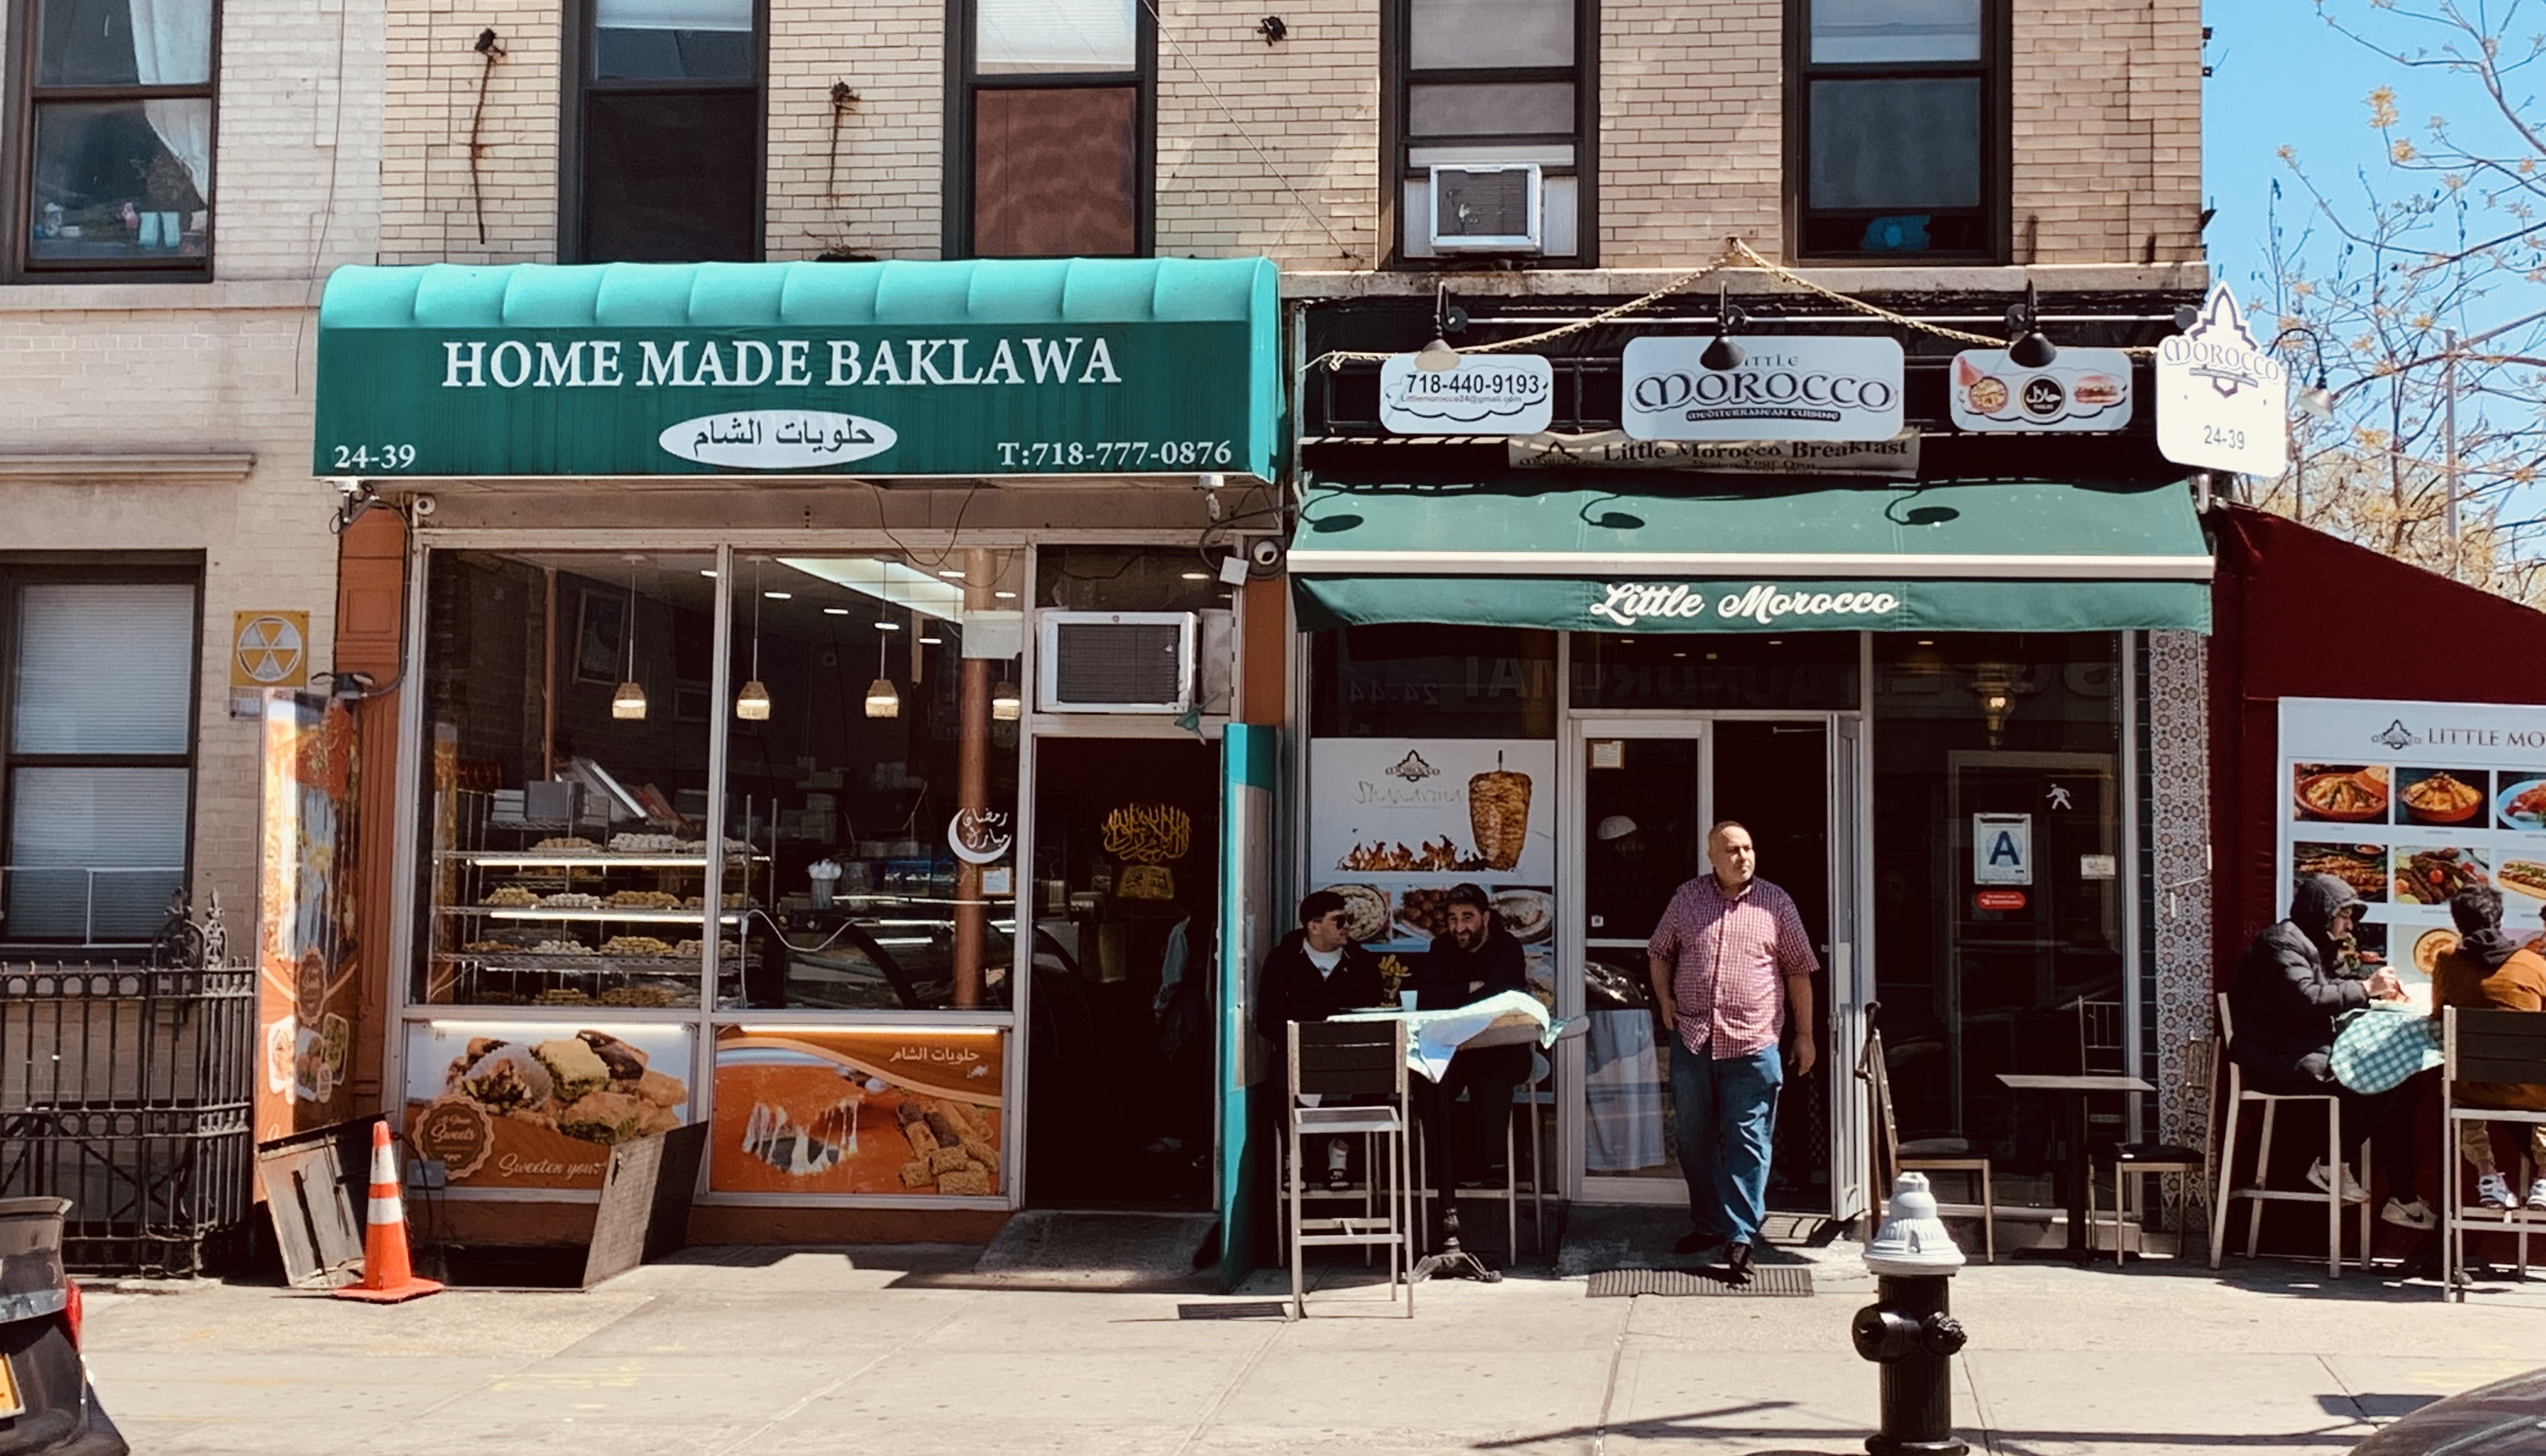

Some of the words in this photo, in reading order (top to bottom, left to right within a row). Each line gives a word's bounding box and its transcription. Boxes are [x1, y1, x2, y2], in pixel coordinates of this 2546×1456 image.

[443, 341, 624, 387] HOME
[635, 341, 811, 386] MADE
[825, 337, 1121, 386] BAKLAWA
[1745, 353, 1799, 367] ITTLE
[2163, 338, 2280, 381] MOROCCO
[1406, 374, 1539, 395] 718-440-9193
[1635, 372, 1891, 408] MOROCCO
[2026, 386, 2062, 403] حلال
[693, 417, 762, 457] الشام
[776, 417, 875, 452] حلويات
[2204, 425, 2245, 450] 24-39
[334, 444, 416, 469] 24-39
[997, 440, 1232, 467] T:718-777-0876
[1605, 443, 1667, 462] Little
[1675, 443, 1781, 458] Morocco
[1589, 582, 1706, 626] Little
[1717, 585, 1899, 624] Morocco
[2428, 727, 2499, 746] LITTLE
[962, 807, 1009, 827] رمضان
[1988, 830, 2021, 866] A
[889, 1046, 928, 1063] الشام
[931, 1047, 980, 1065] حلويات
[430, 1123, 478, 1144] Sweets
[498, 1152, 564, 1178] Sweeten
